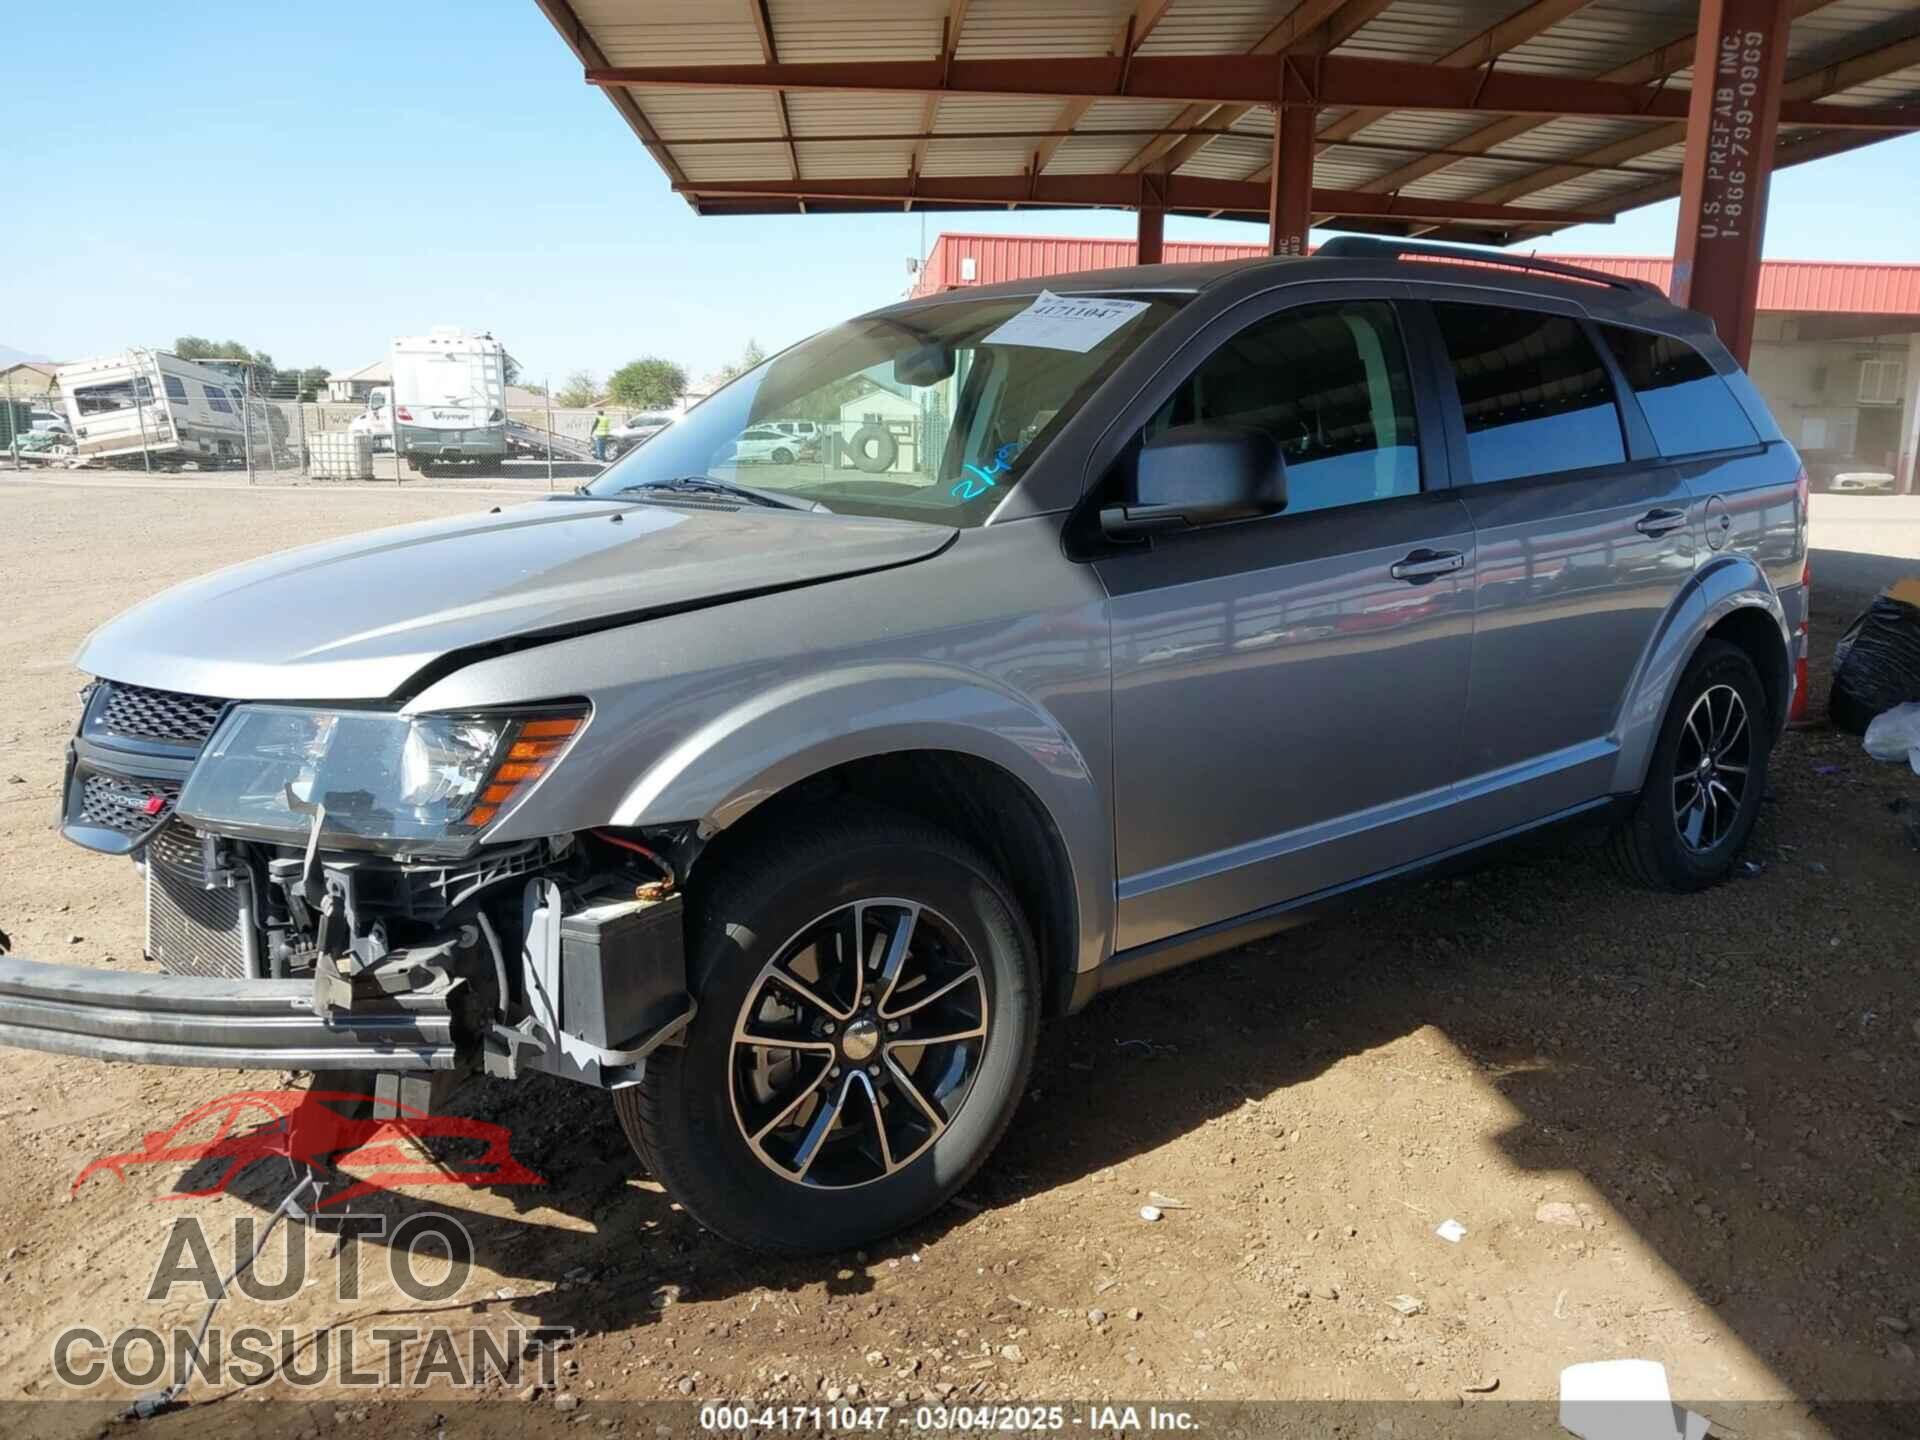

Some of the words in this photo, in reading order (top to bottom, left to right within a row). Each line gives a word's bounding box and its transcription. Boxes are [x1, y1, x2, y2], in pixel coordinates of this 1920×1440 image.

[1719, 29, 1743, 75] INC.
[1708, 87, 1735, 180] PREFAB
[1721, 31, 1764, 237] 1-866-799-0969
[1700, 194, 1723, 238] U.S.
[1034, 306, 1123, 319] 41711047
